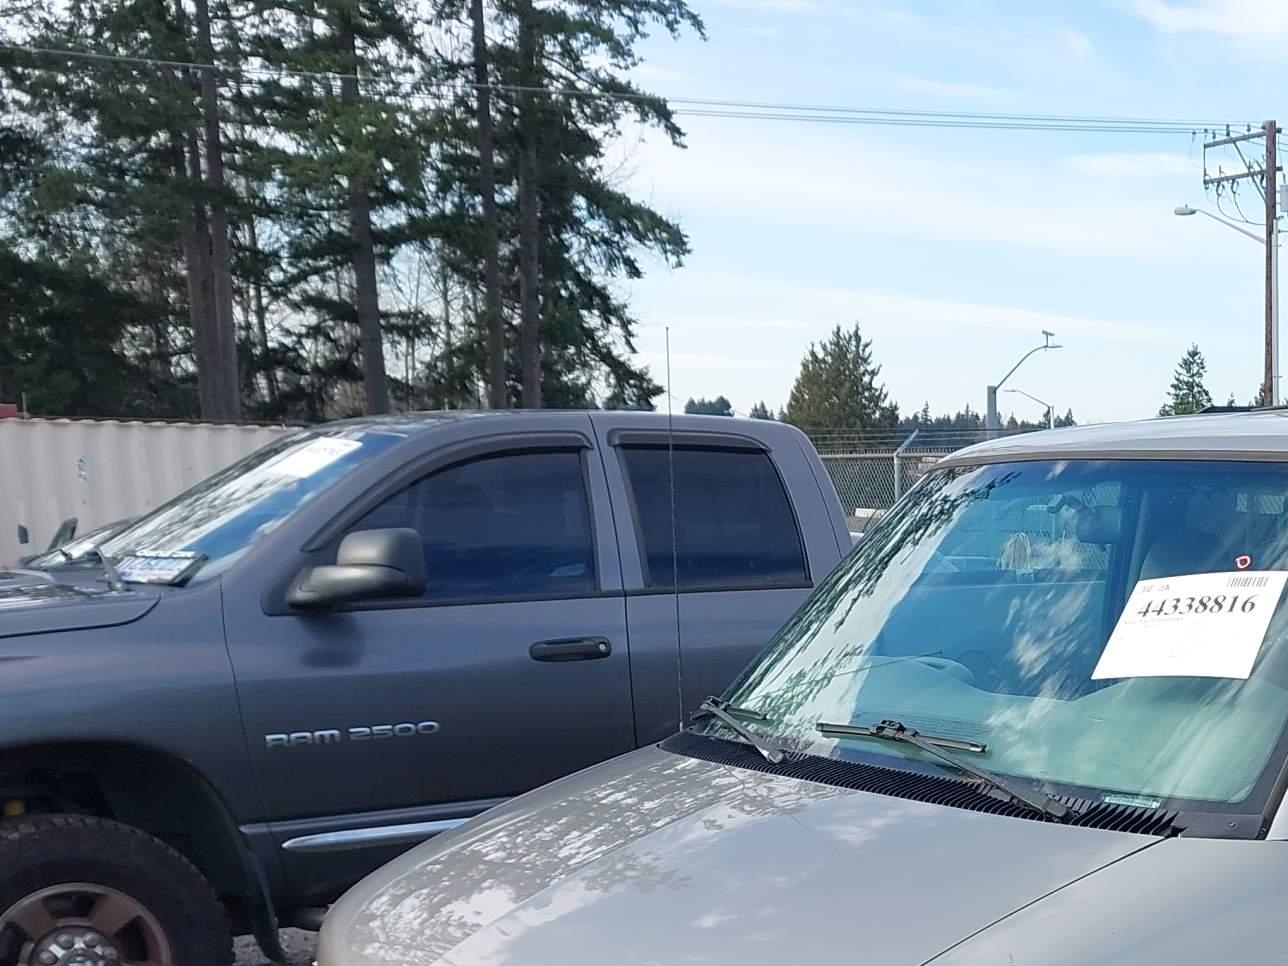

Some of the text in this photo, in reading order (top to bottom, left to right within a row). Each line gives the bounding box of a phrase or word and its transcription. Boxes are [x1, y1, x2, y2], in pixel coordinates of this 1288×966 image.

[1136, 594, 1260, 618] 44338816
[265, 720, 440, 748] RAM 2500
